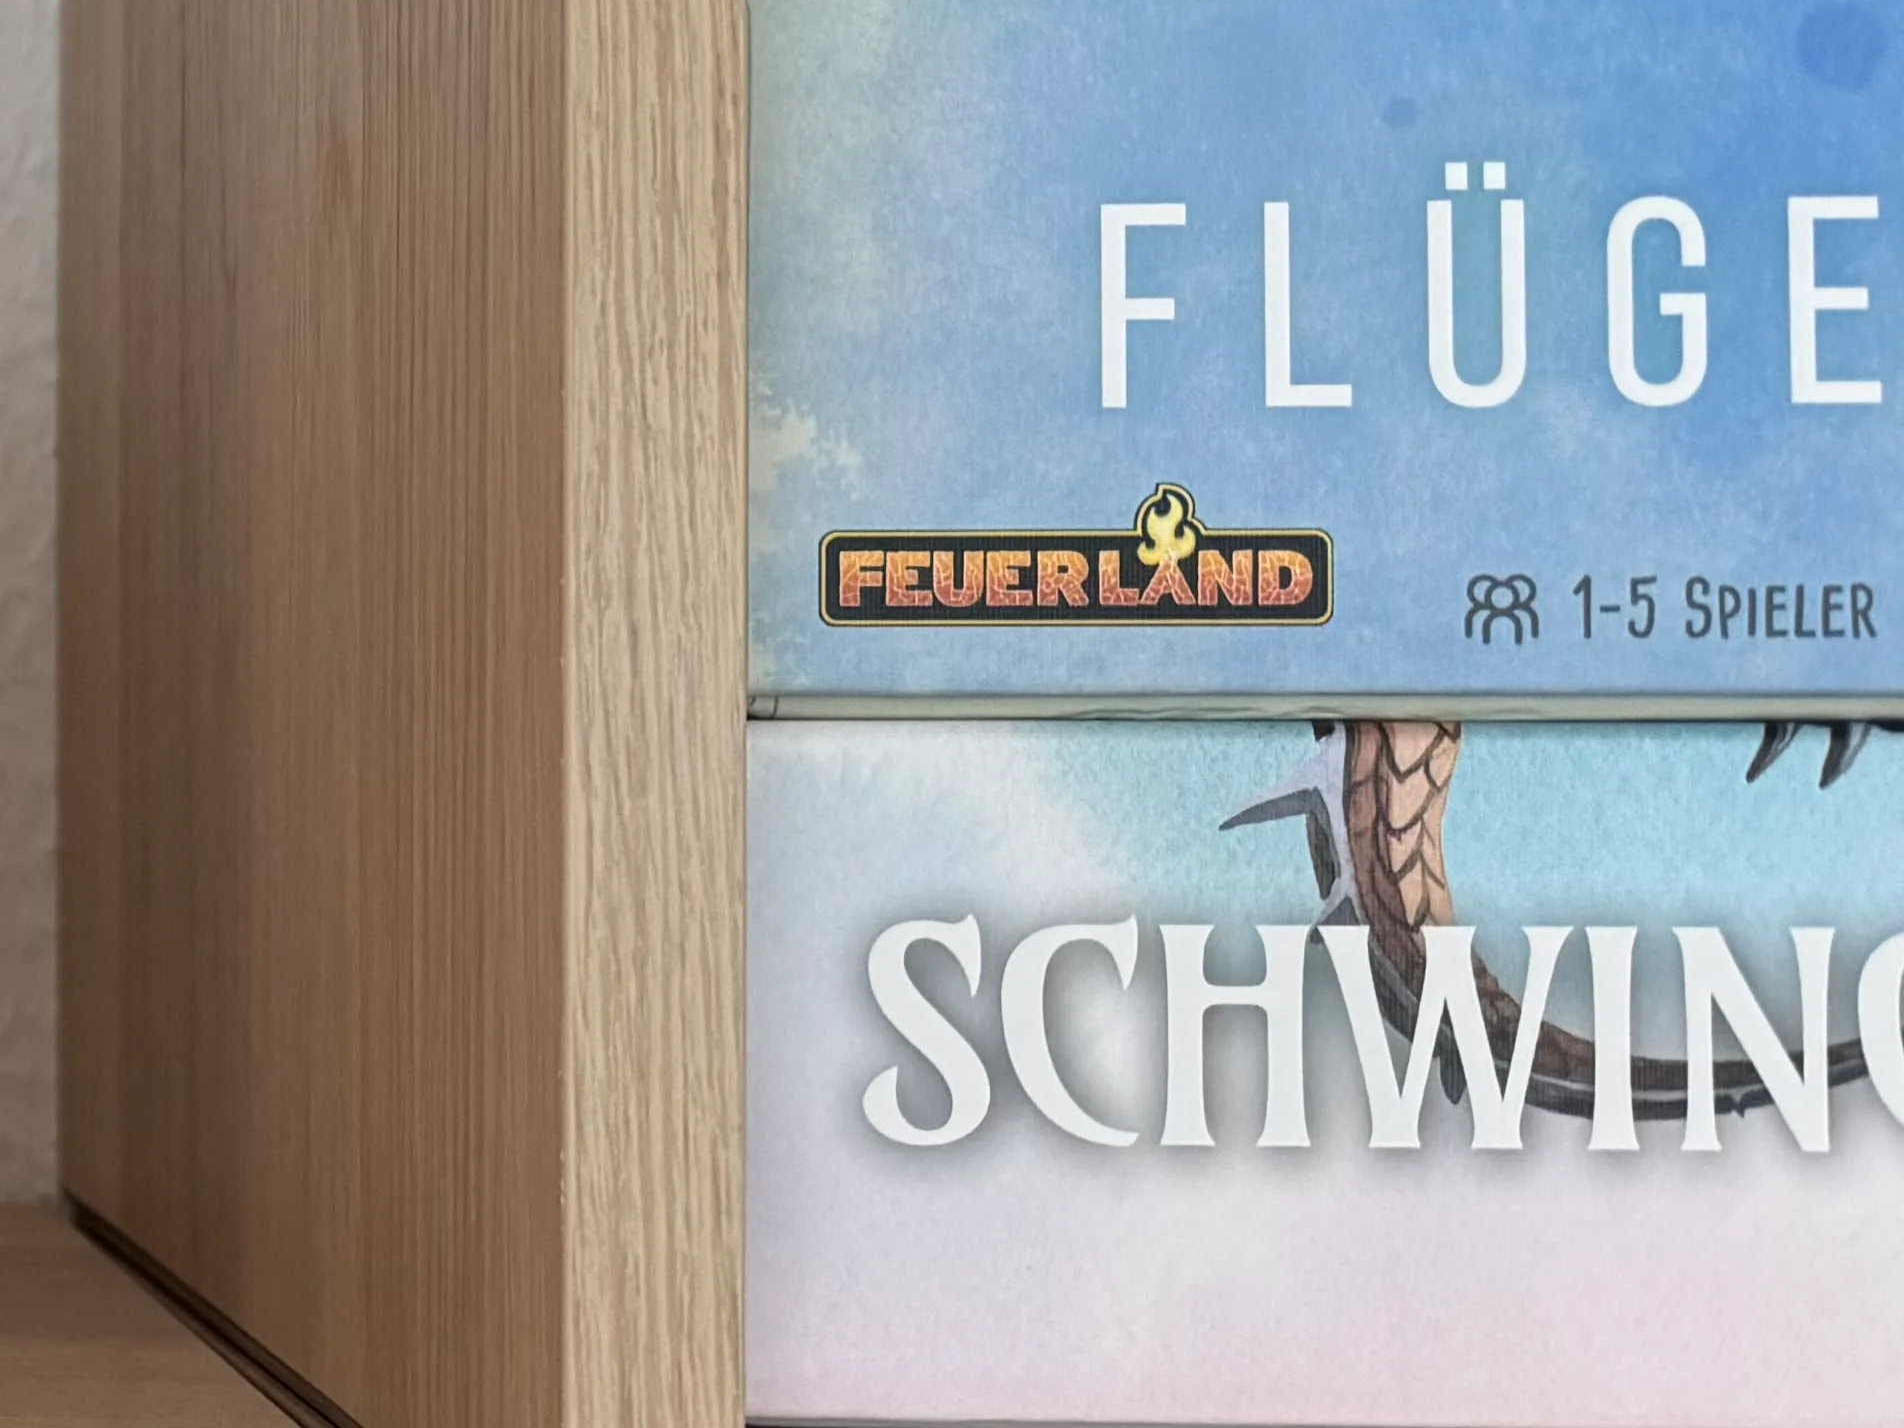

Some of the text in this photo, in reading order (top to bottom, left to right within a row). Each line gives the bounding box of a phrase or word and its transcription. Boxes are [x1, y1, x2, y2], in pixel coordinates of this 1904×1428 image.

[1099, 162, 1883, 410] FLÜGE
[838, 545, 1314, 609] FEUERLAND
[1571, 574, 1658, 640] 1-5
